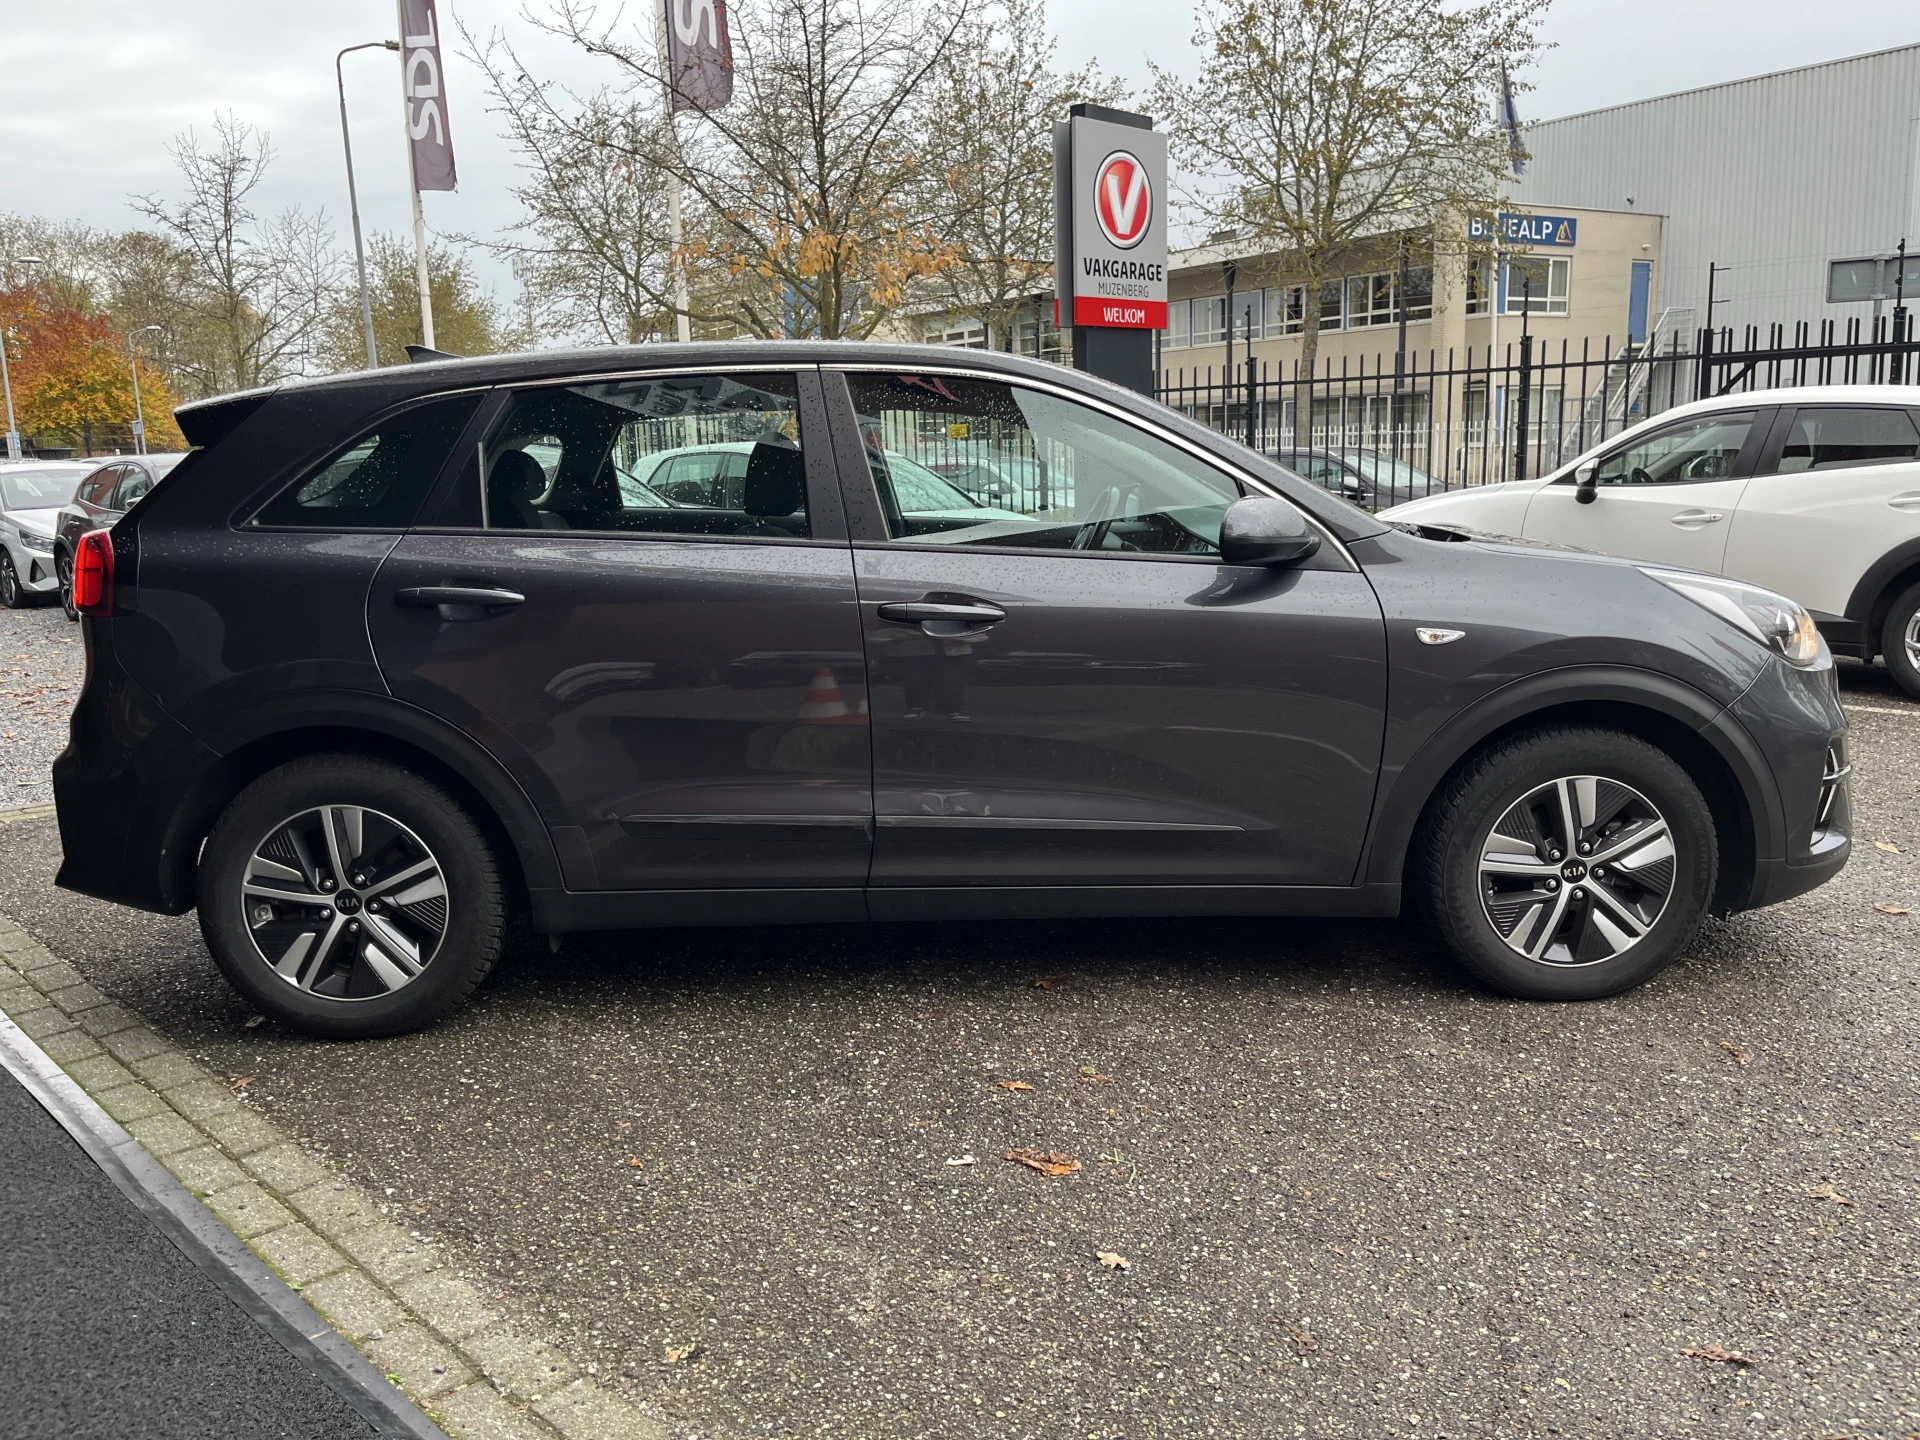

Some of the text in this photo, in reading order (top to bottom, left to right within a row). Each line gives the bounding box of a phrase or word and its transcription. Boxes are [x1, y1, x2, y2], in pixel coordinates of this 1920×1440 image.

[405, 9, 444, 146] SDL
[1083, 257, 1162, 282] VAKGARAGE
[1098, 282, 1149, 297] MUZENBERG
[1103, 307, 1145, 324] WELKOM
[1563, 866, 1586, 878] KIA
[336, 898, 359, 908] KIA
